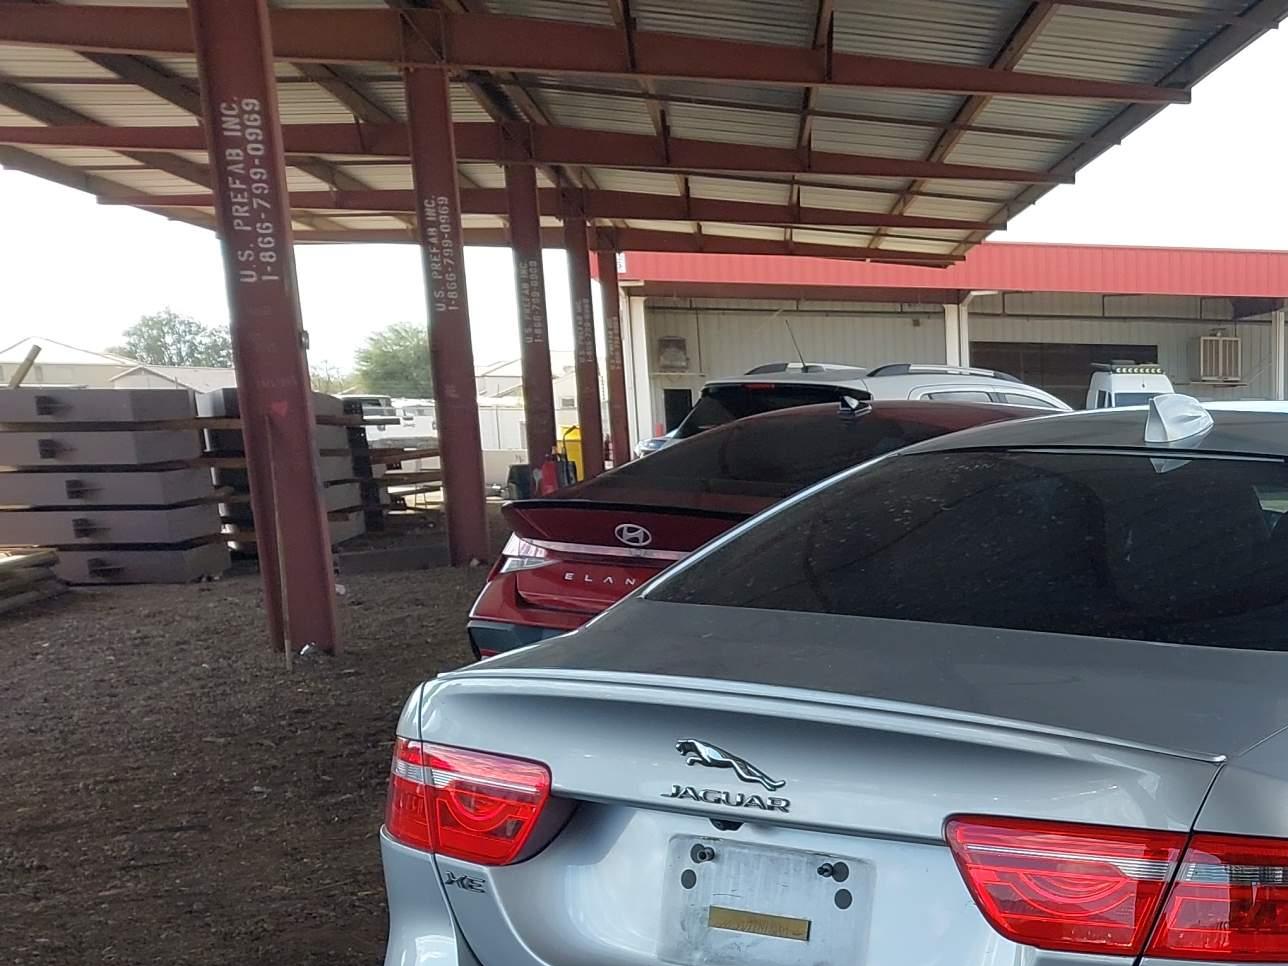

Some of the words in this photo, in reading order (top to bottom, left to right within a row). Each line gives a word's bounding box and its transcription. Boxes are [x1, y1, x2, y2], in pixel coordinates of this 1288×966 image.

[220, 96, 241, 136] INC.
[225, 148, 252, 231] PREFAB
[241, 98, 279, 281] 1-866-799-0969
[423, 195, 437, 221] INC.
[238, 244, 257, 282] U.S.
[426, 227, 443, 280] PREFAB
[436, 196, 459, 311] 1-866-799-0969
[433, 287, 446, 312] U.S.
[660, 784, 791, 813] JAGUAR
[445, 871, 486, 893] XE
